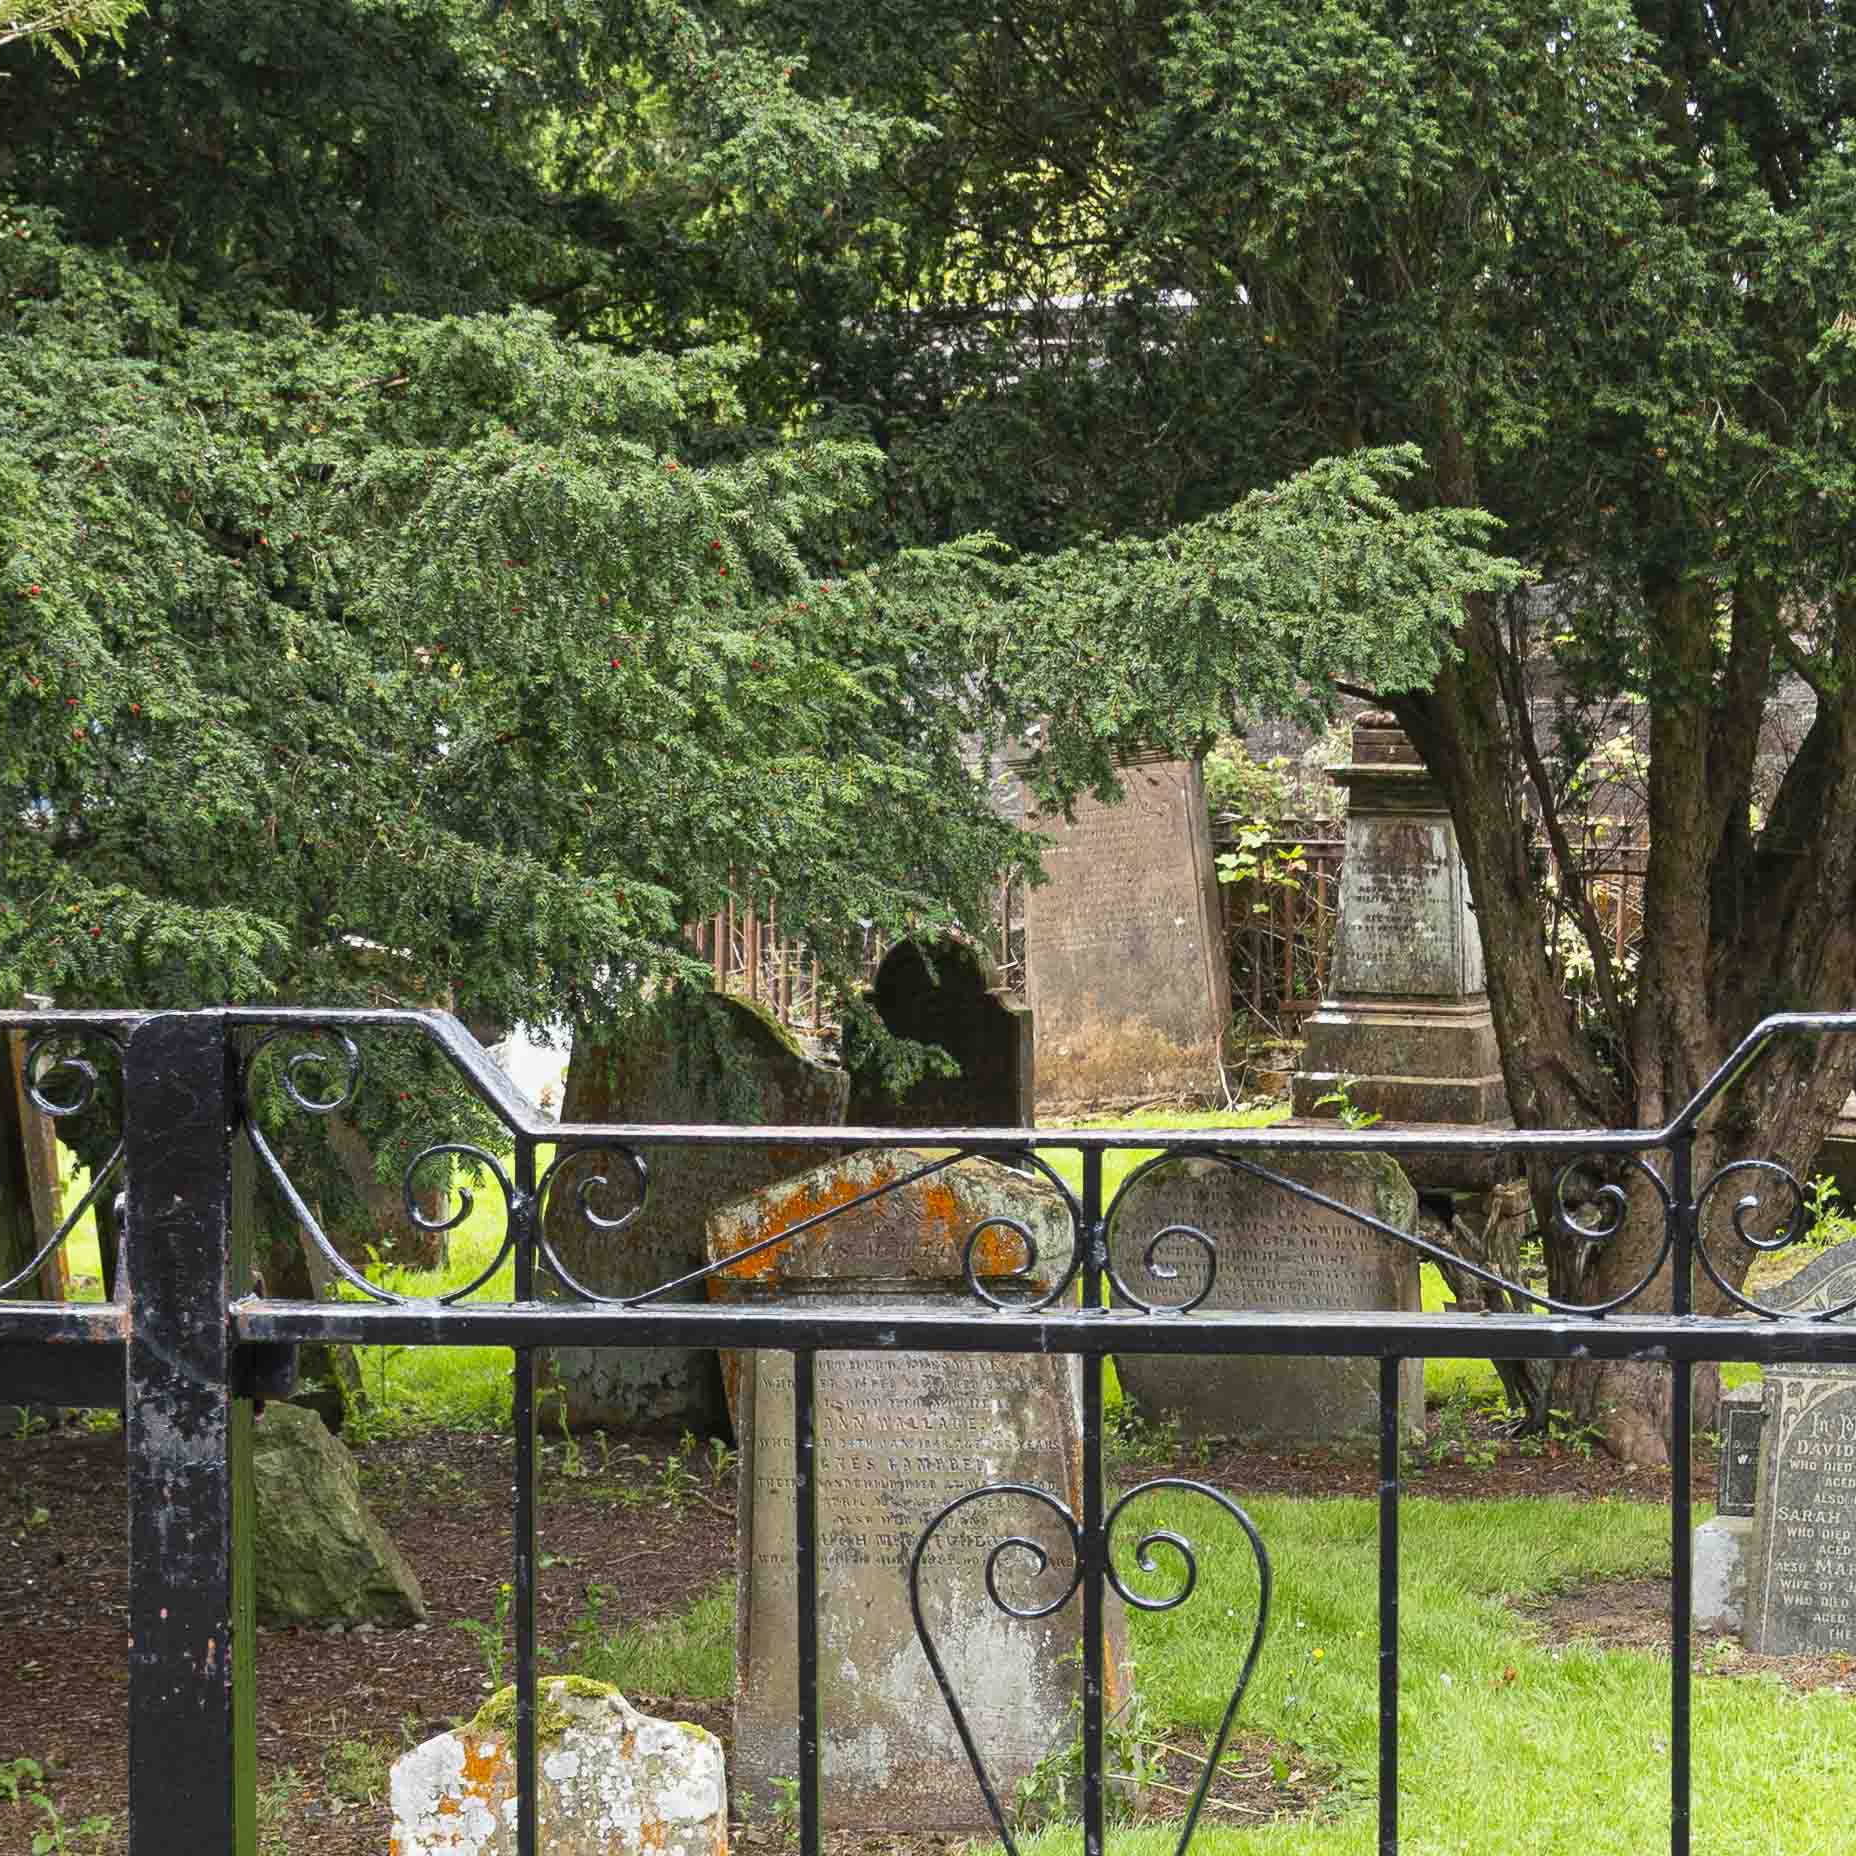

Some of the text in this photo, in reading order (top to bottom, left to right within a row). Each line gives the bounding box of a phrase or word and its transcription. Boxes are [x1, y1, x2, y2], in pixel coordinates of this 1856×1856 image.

[1797, 1440, 1854, 1457] DAVID
[1789, 1458, 1817, 1471] WHO
[1824, 1461, 1852, 1473] DIED
[1824, 1477, 1856, 1489] AGED
[1814, 1493, 1844, 1505] ALSO
[1777, 1506, 1841, 1524] SARAH
[1787, 1527, 1815, 1538] WHO
[1822, 1529, 1850, 1541] DIED
